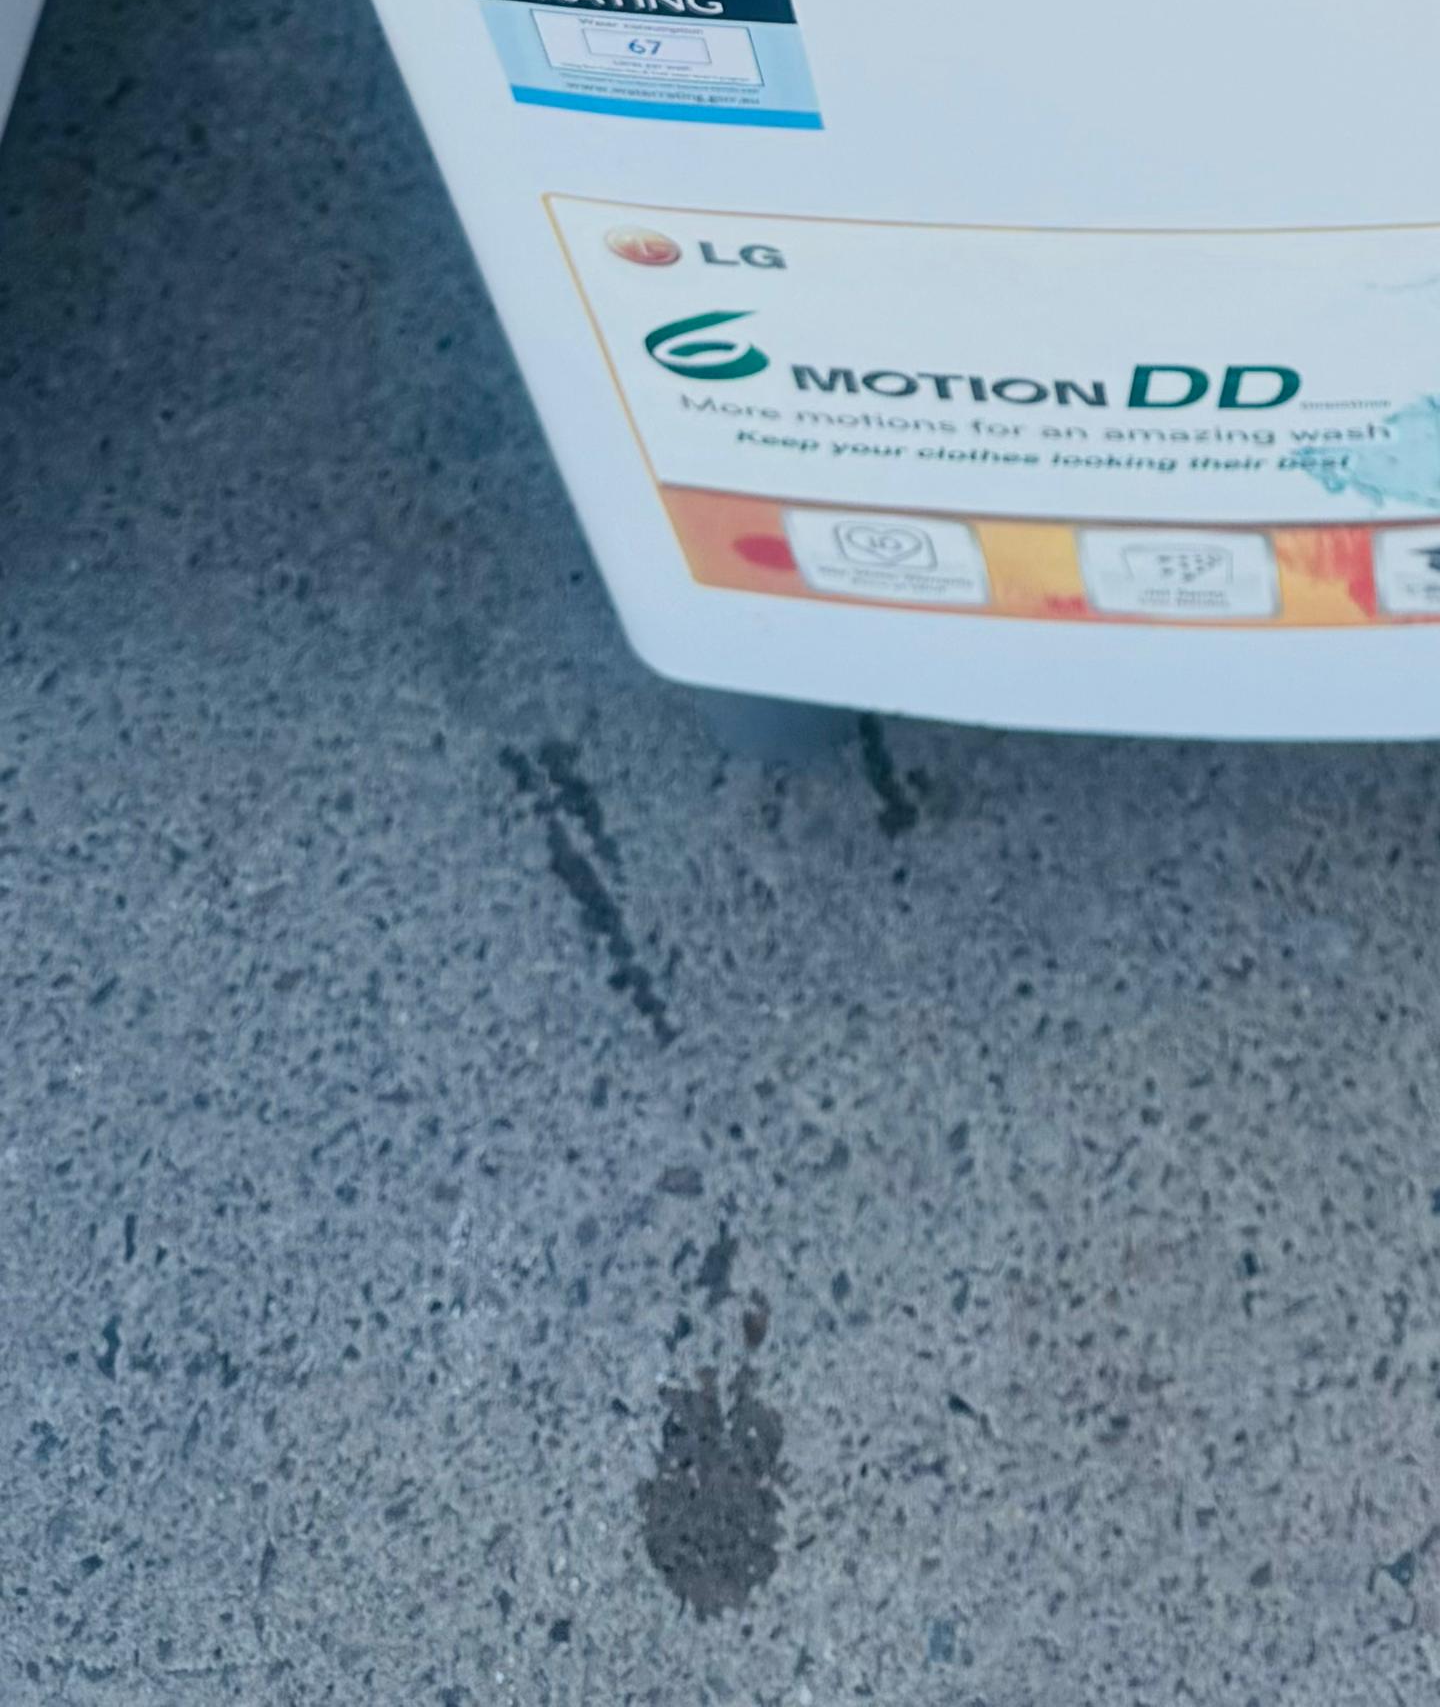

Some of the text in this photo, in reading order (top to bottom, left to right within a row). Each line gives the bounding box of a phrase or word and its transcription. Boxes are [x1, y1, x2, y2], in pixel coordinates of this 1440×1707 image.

[627, 37, 663, 56] 67
[698, 240, 788, 270] LG
[791, 363, 1110, 407] MOTION
[1128, 363, 1303, 410] DD
[680, 392, 1392, 445] More motions for an amazing wash
[735, 429, 1352, 472] Keep your clothes looking their best
